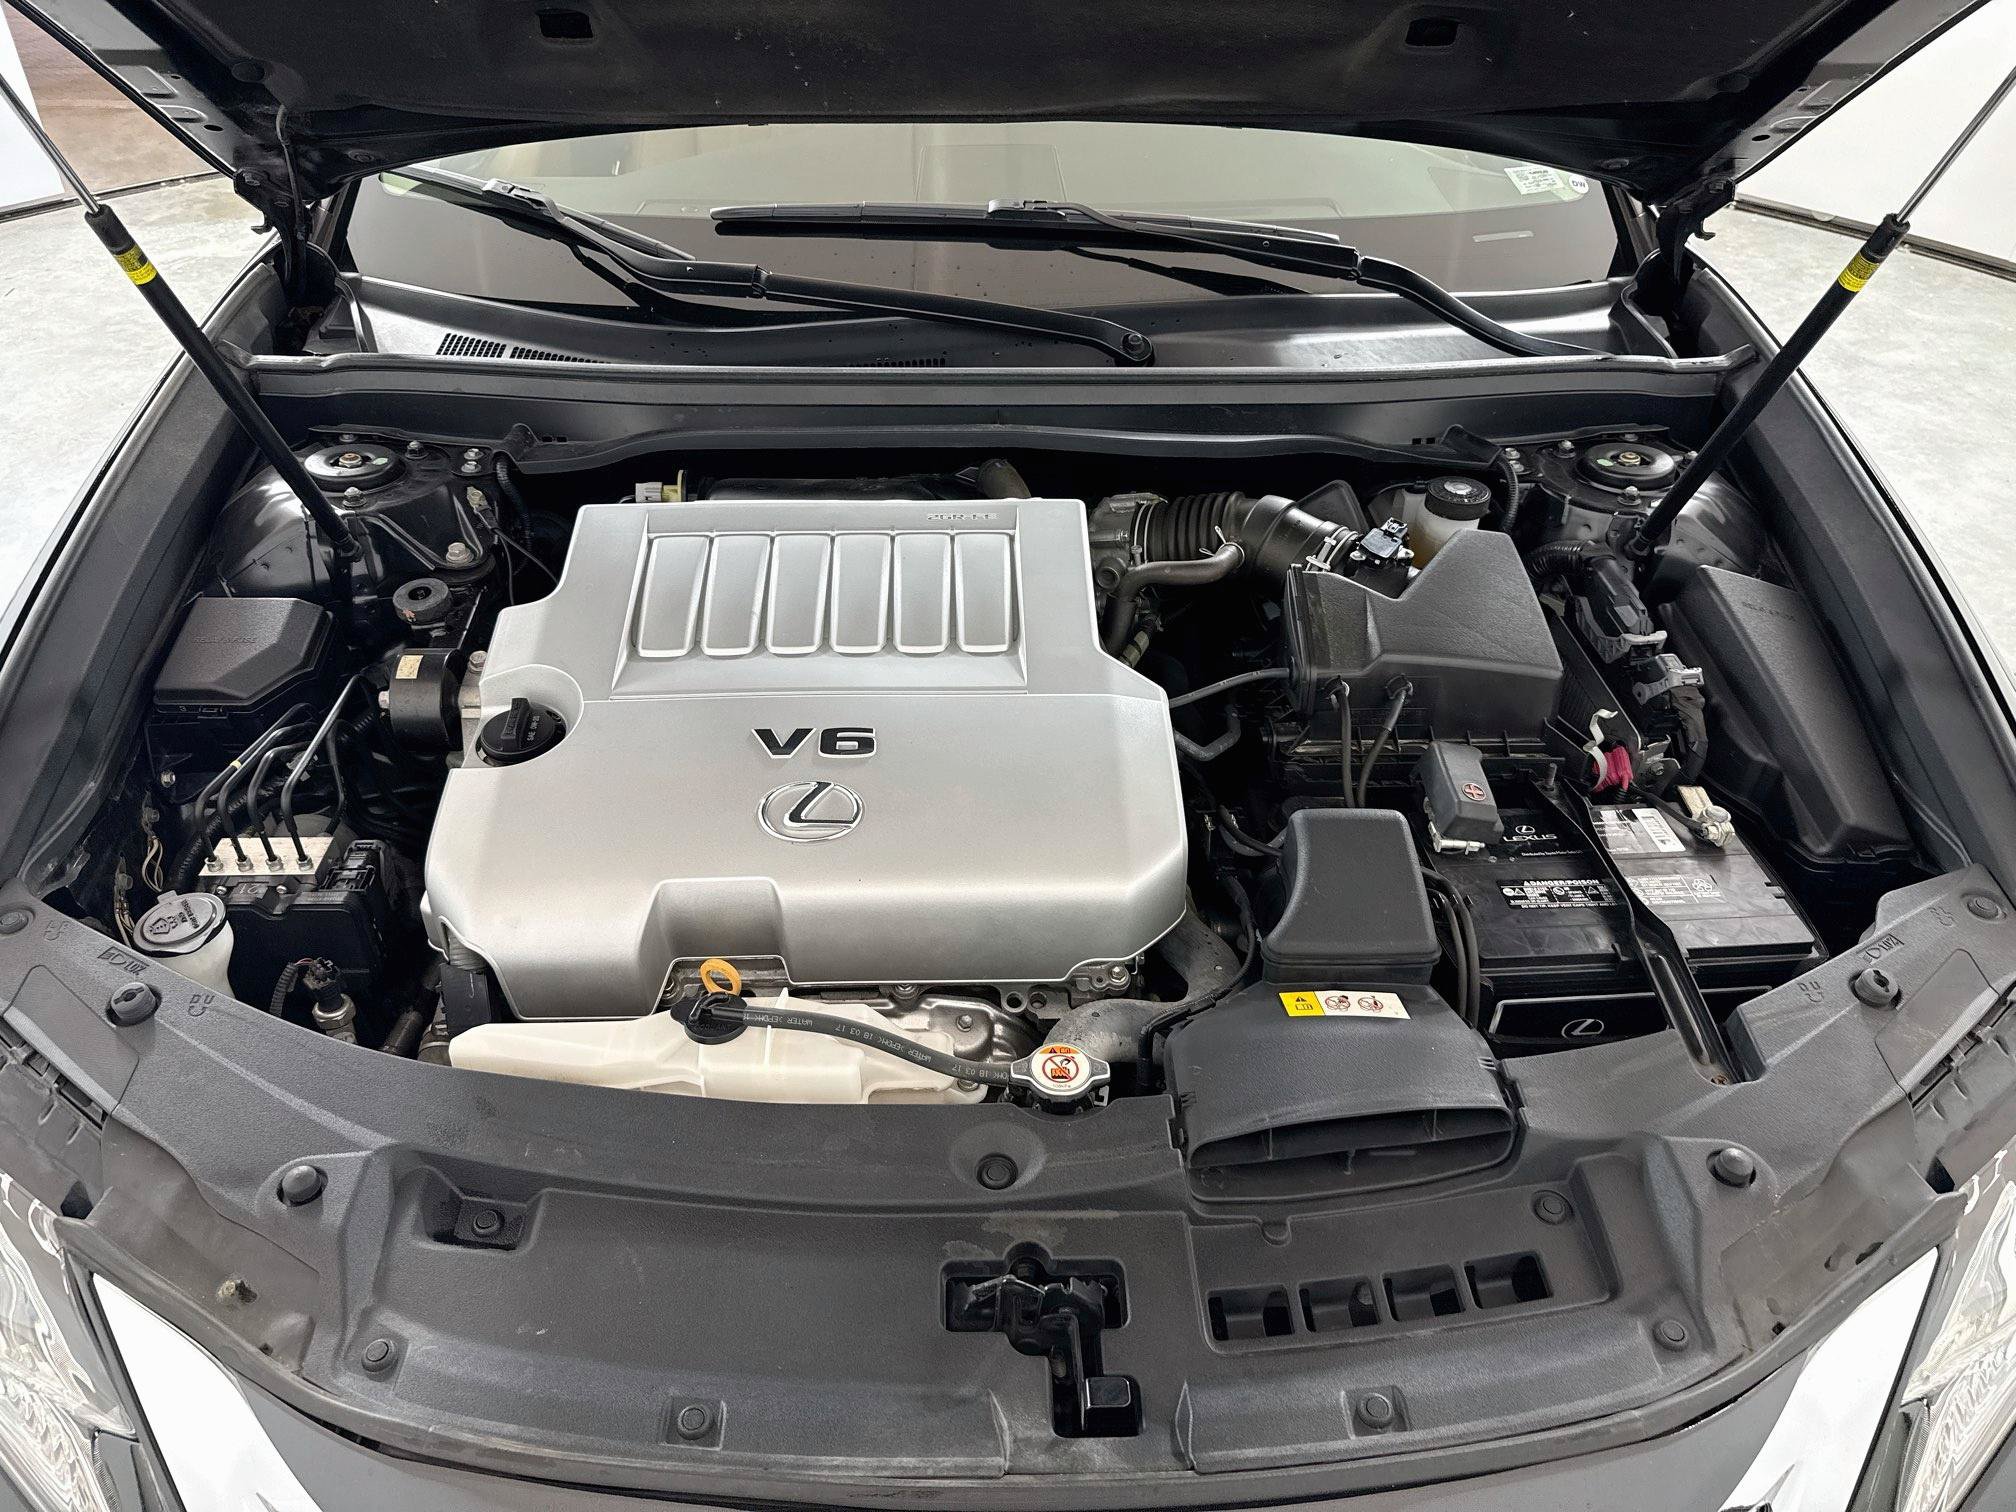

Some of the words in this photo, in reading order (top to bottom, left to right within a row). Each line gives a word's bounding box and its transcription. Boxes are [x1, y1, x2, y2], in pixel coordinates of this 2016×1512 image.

[751, 727, 876, 759] V6
[1503, 834, 1557, 842] LEXUS
[786, 1017, 813, 1027] WATER
[908, 1050, 931, 1063] WATER
[965, 1067, 976, 1076] 03
[979, 1070, 989, 1078] 18
